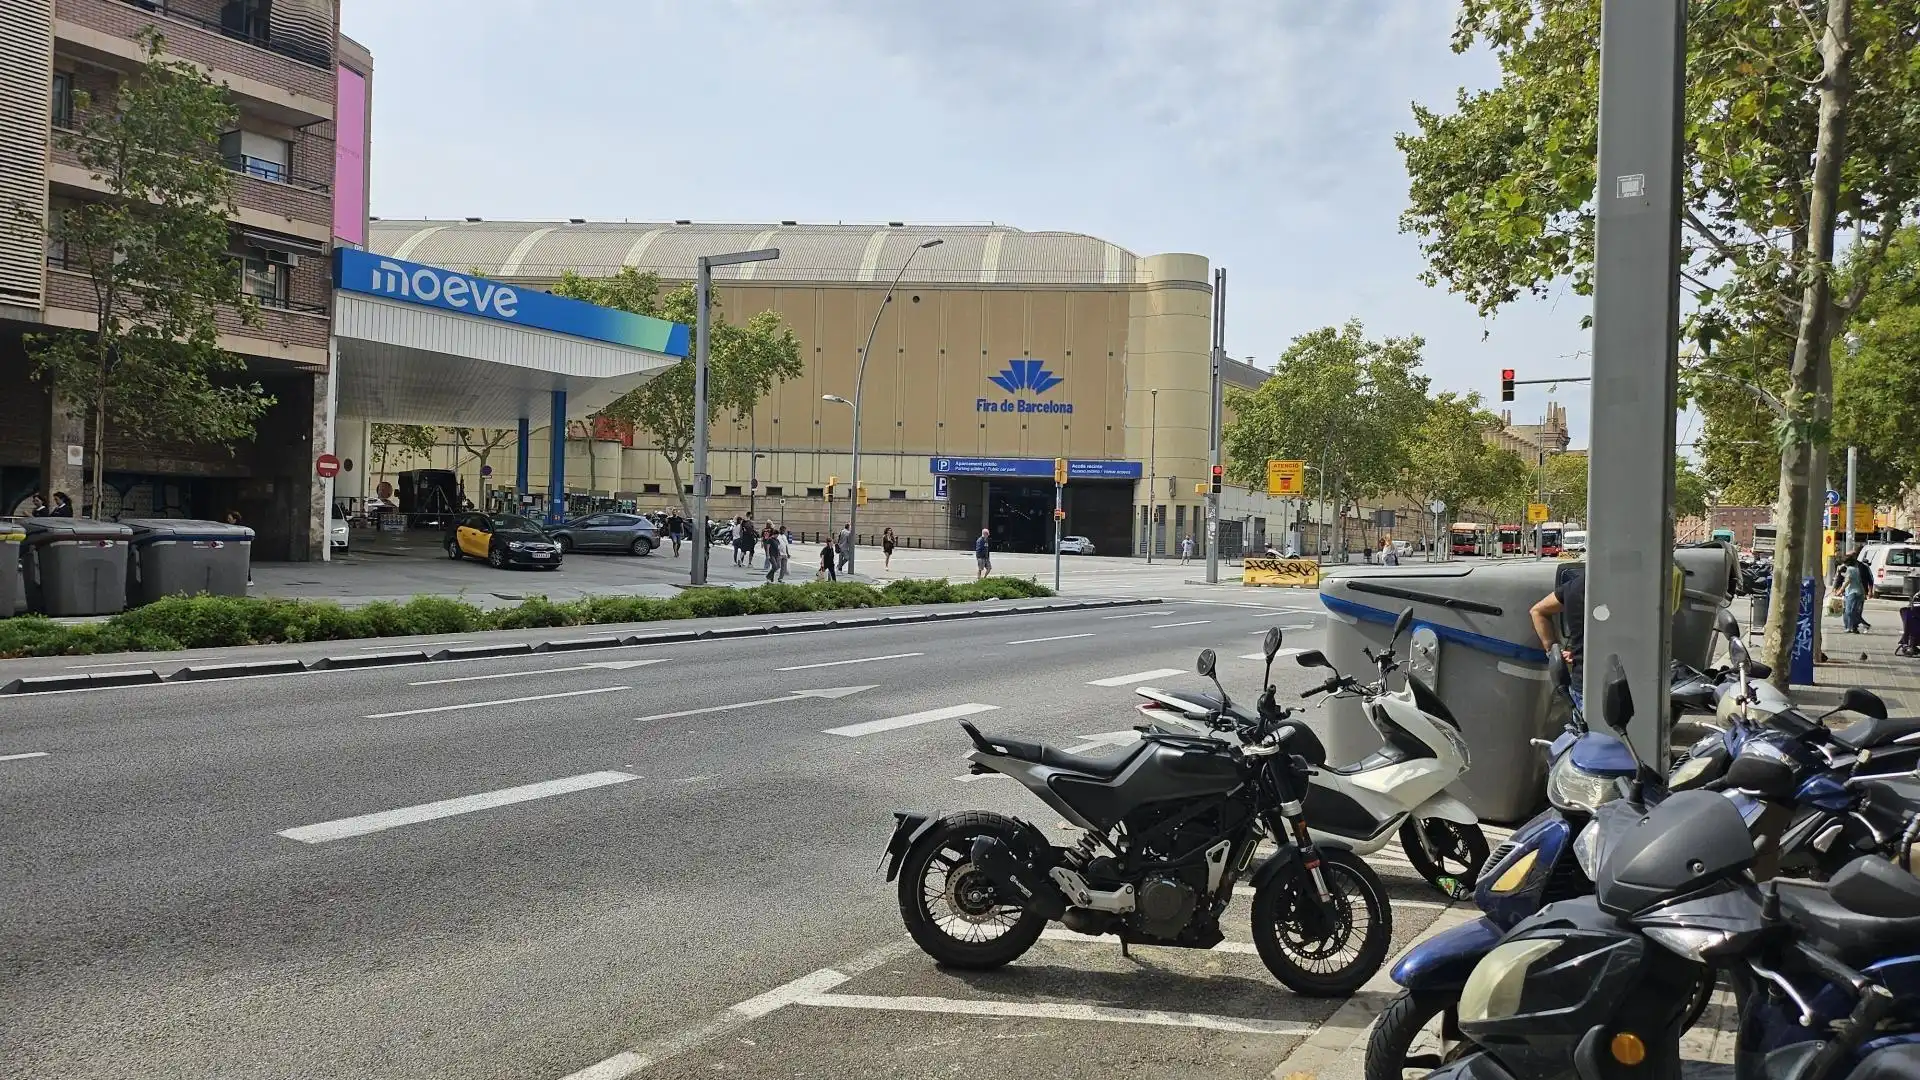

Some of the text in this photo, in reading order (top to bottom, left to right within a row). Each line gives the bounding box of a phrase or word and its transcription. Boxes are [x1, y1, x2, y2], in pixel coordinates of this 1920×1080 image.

[372, 260, 518, 317] moeve
[976, 398, 1073, 414] Fira de Barcelona
[939, 477, 947, 491] P
